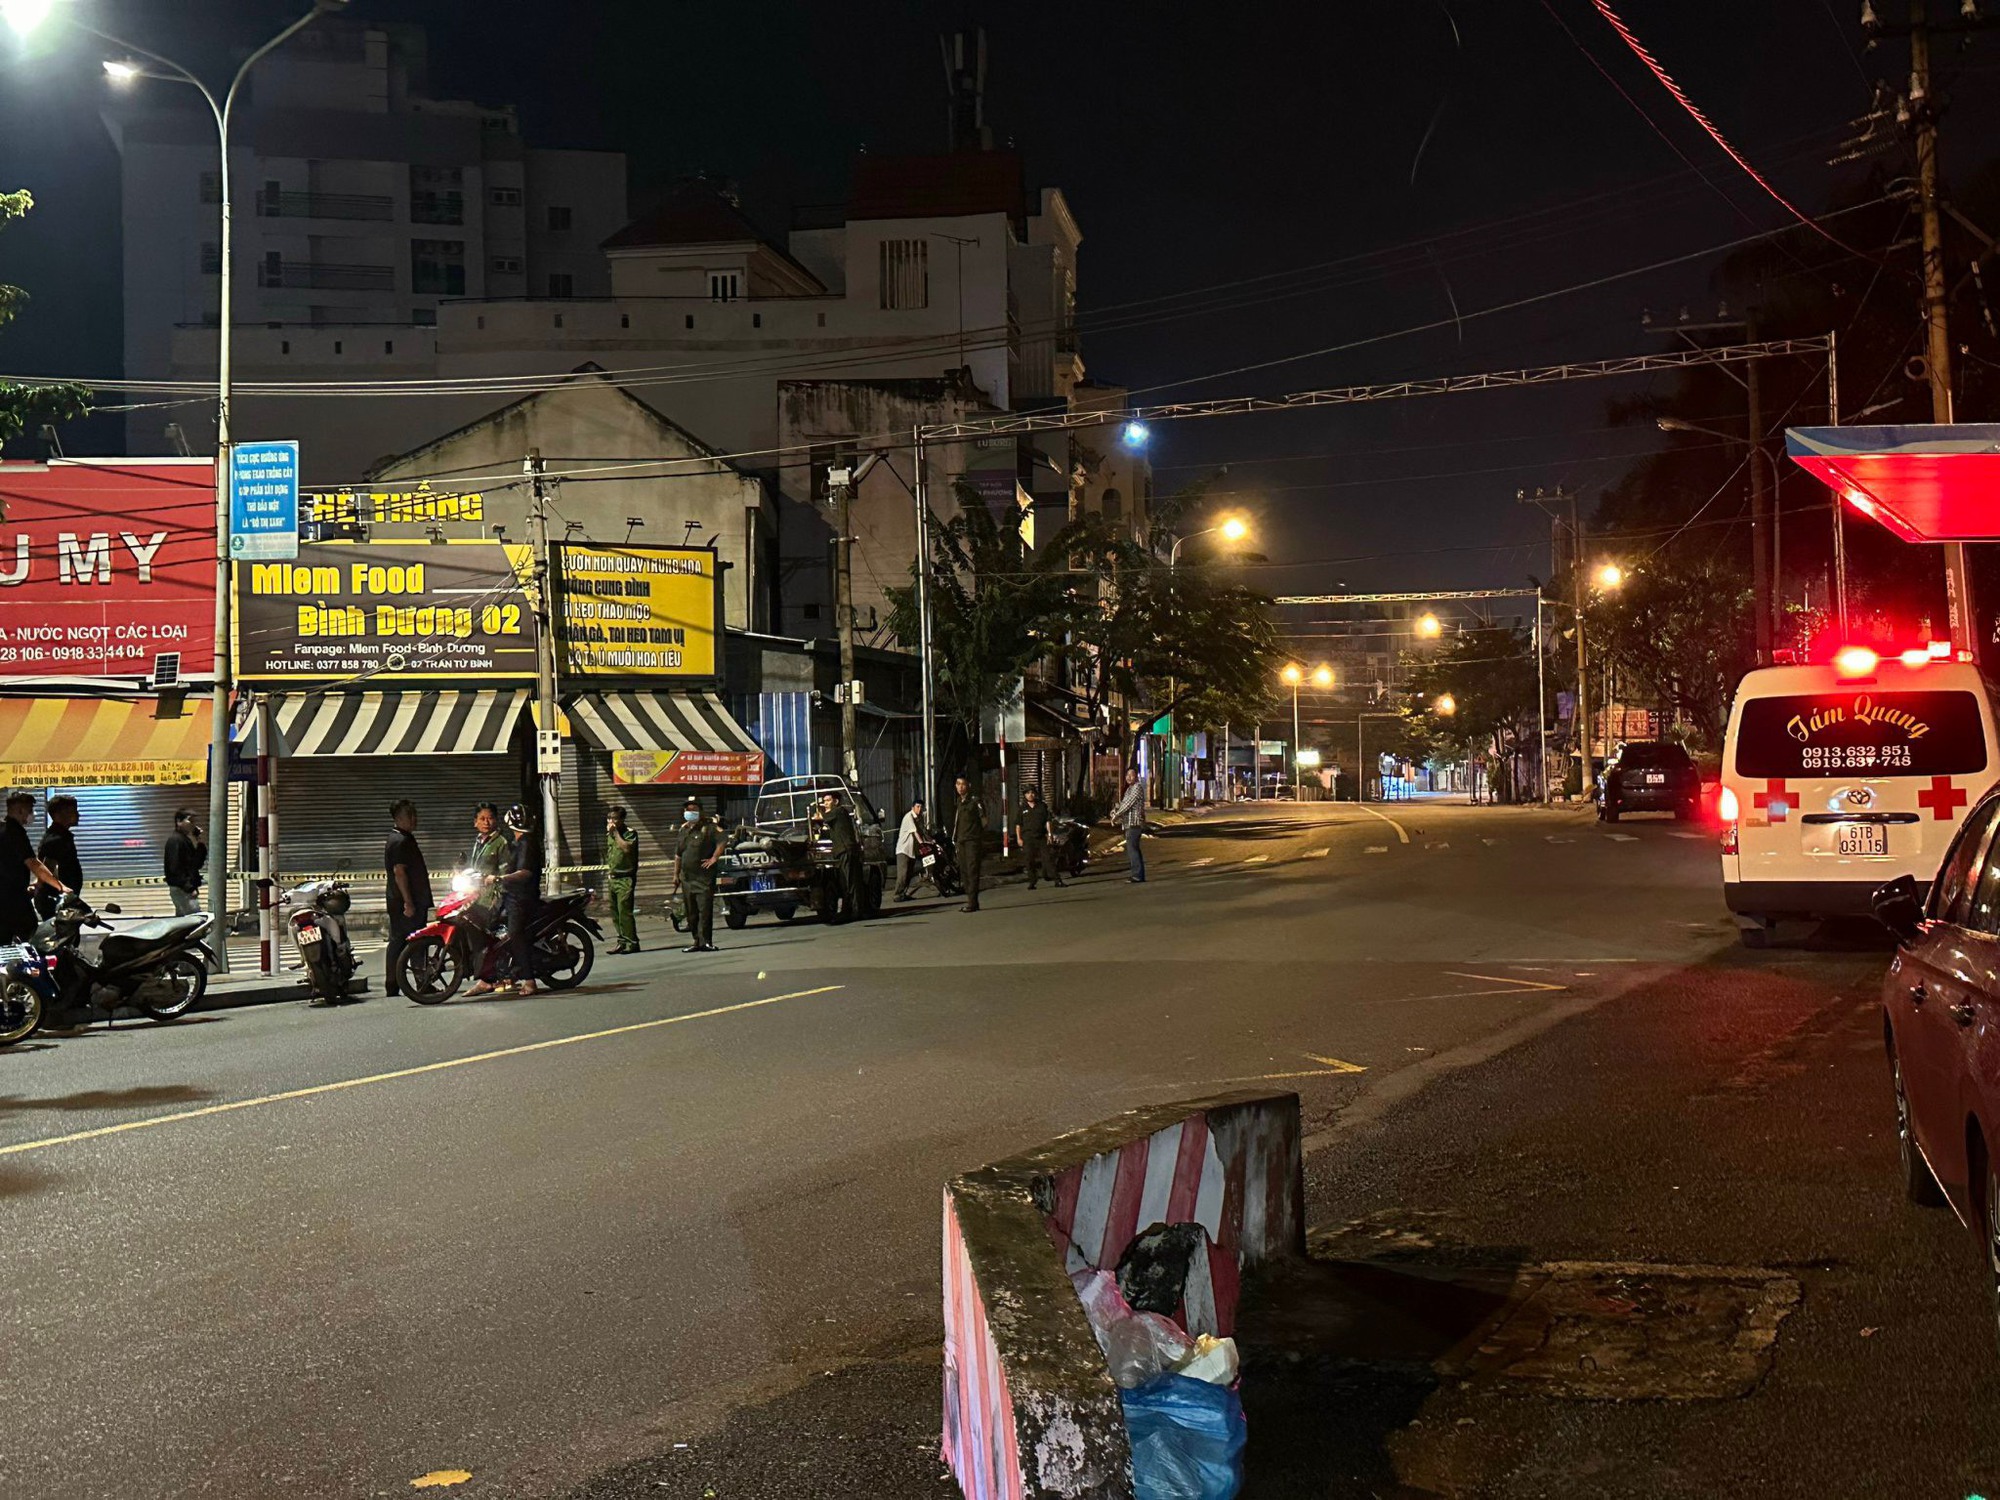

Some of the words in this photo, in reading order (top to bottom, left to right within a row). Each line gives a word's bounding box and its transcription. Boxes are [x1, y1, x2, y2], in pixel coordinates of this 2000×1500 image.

[592, 556, 614, 572] NON
[616, 556, 644, 572] QUAY
[680, 558, 702, 574] HOA
[352, 563, 426, 596] Food
[594, 580, 623, 596] CUNG
[625, 577, 650, 597] ĐÌNH
[298, 600, 366, 636] Bình
[376, 604, 473, 638] Dương
[482, 604, 522, 635] 02
[575, 602, 595, 618] HEO
[68, 626, 111, 643] NGỌT
[115, 622, 148, 639] CÁC
[152, 625, 188, 642] LOẠI
[608, 627, 626, 643] TAI
[627, 627, 648, 643] HEO
[648, 628, 672, 644] TAM
[20, 647, 44, 660] 106
[294, 643, 346, 656] Fanpage:
[448, 643, 485, 656] Dương
[608, 646, 636, 666] MUỐI
[636, 652, 658, 666] HOA
[659, 649, 682, 666] TIÊU
[266, 660, 314, 670] HOTLINE:
[316, 660, 340, 670] 0377
[341, 660, 360, 669] 858
[362, 660, 379, 669] 780
[1854, 694, 1930, 738] Quang
[1850, 826, 1872, 838] 61B
